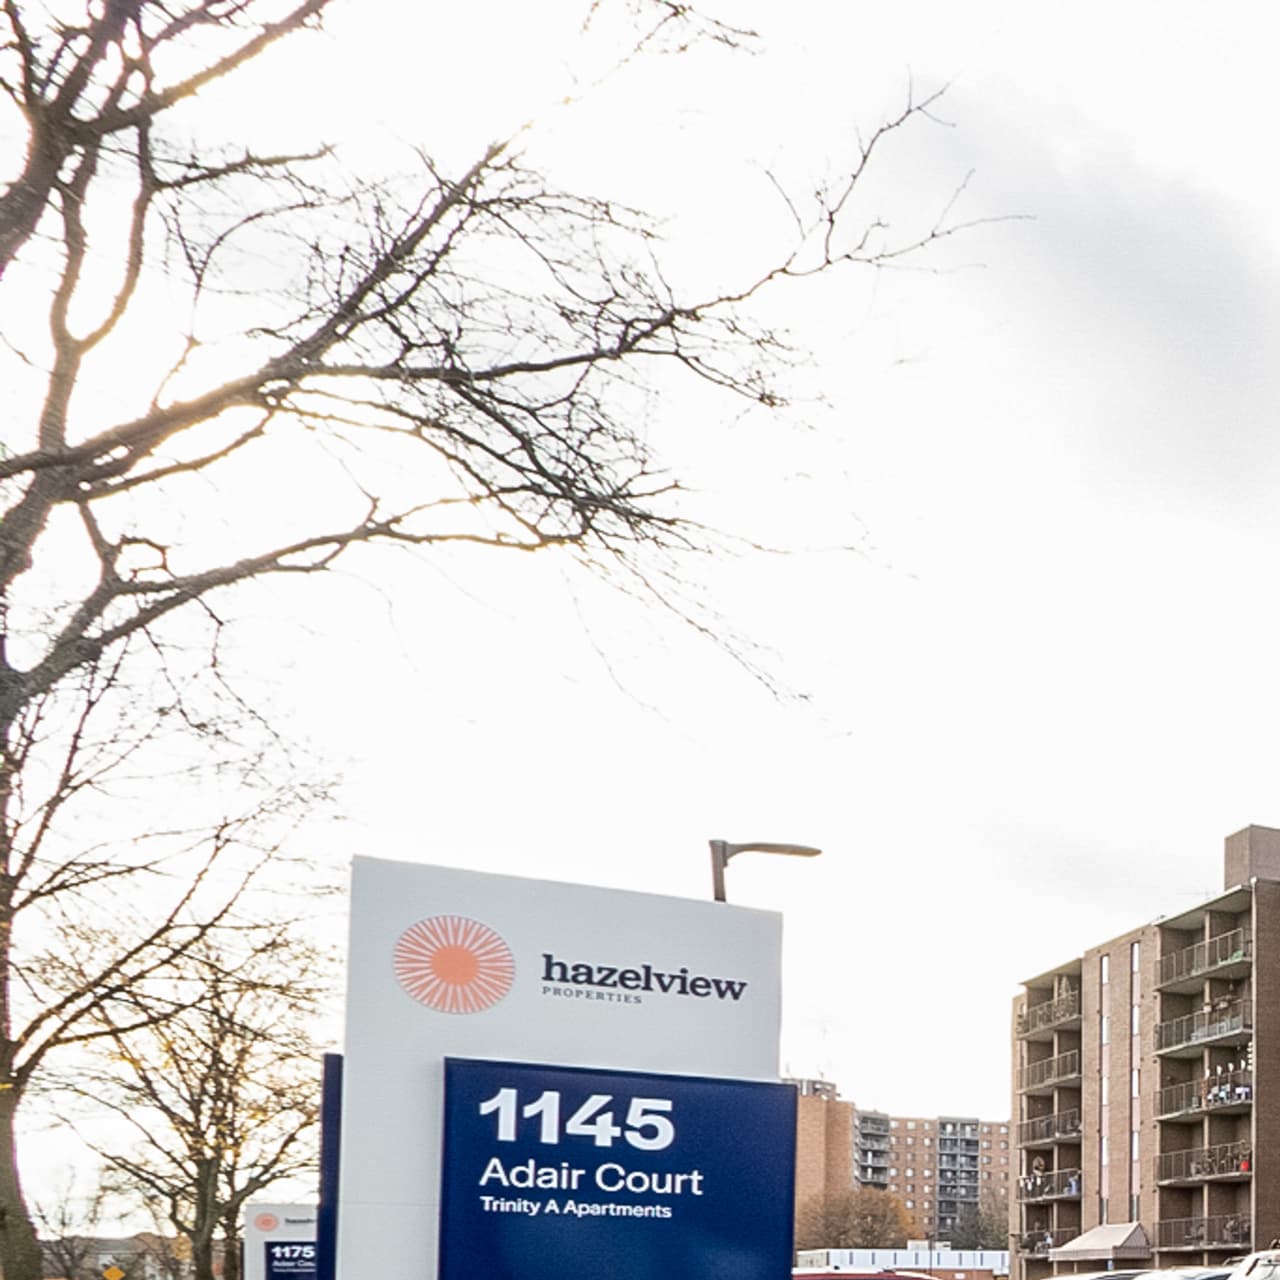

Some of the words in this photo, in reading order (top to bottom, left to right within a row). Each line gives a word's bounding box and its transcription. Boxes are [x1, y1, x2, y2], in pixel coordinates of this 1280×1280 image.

[542, 953, 748, 1001] hazelview
[542, 986, 643, 1004] PROPERTIES
[479, 1087, 675, 1151] 1145
[479, 1157, 586, 1190] Adair
[595, 1163, 704, 1195] Court
[479, 1195, 541, 1217] Trinity
[545, 1199, 560, 1214] A
[563, 1200, 673, 1218] Apartments
[271, 1246, 316, 1259] 1175
